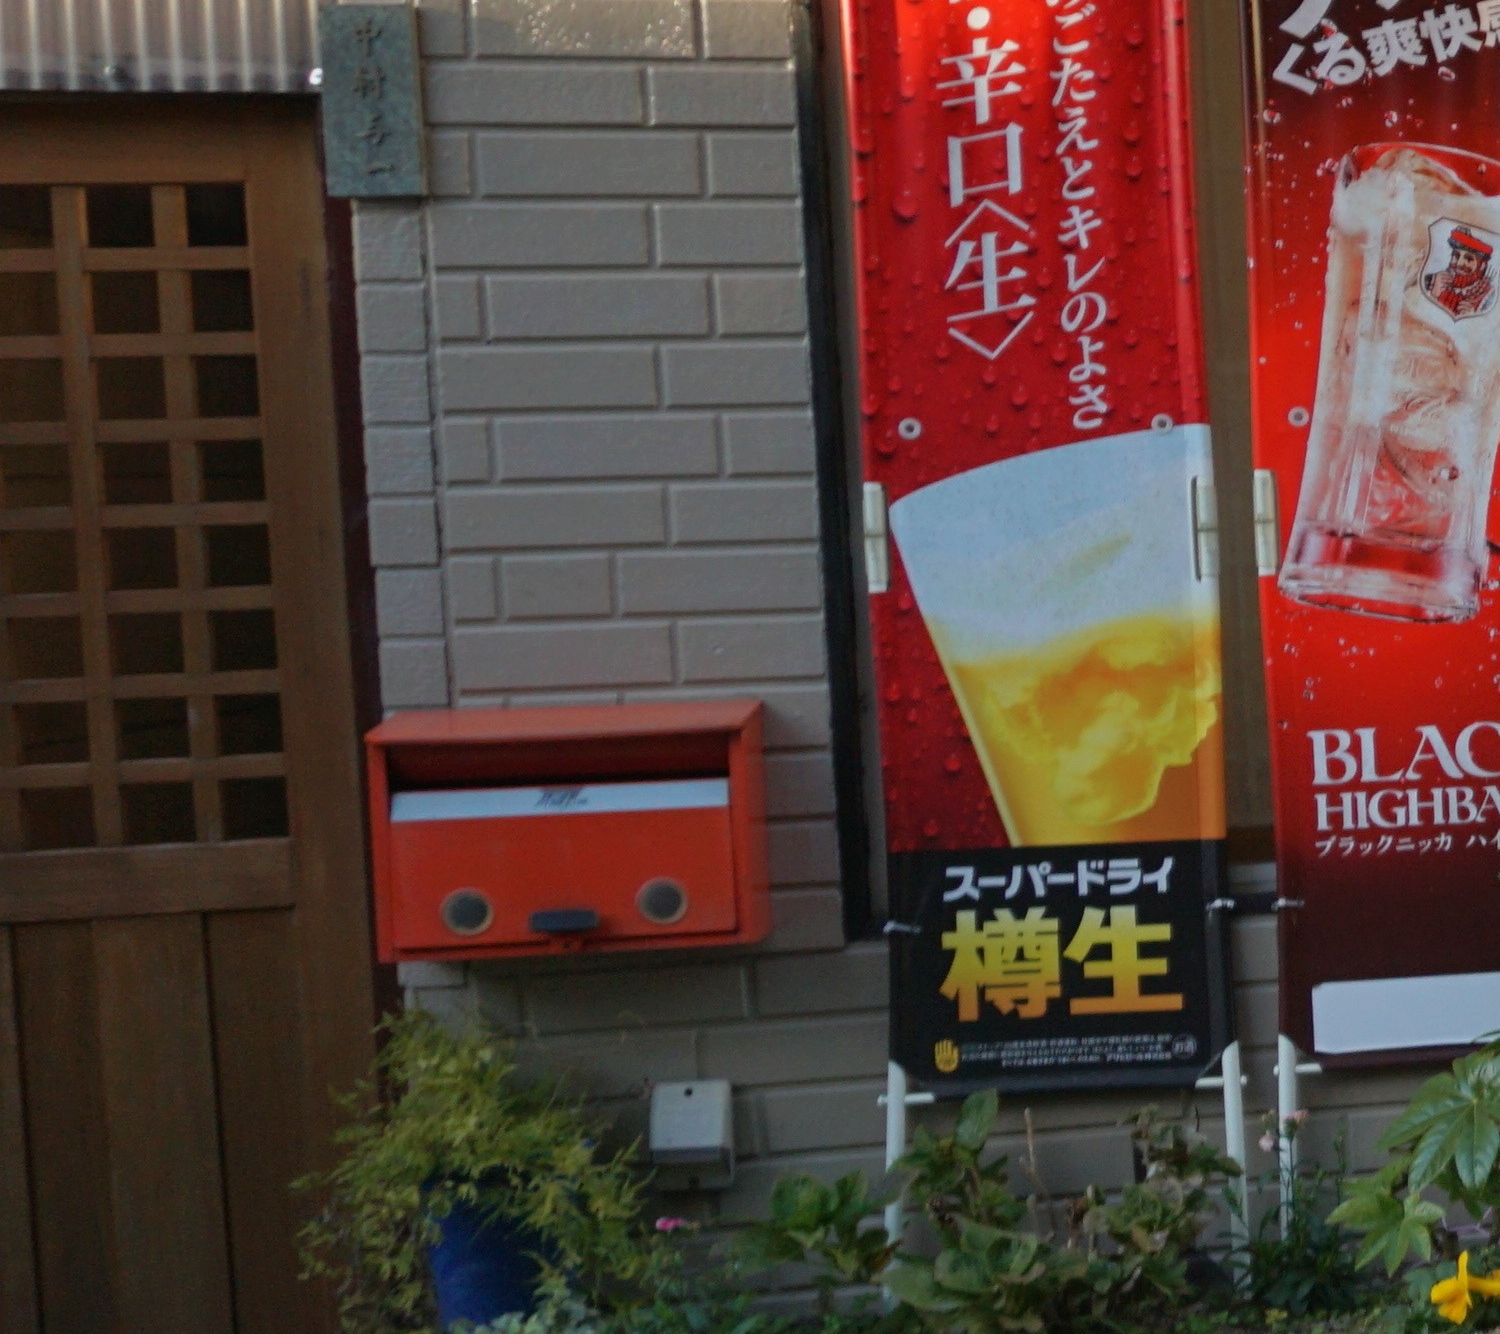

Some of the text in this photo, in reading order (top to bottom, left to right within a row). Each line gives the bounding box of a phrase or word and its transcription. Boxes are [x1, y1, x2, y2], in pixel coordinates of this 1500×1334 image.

[1315, 831, 1453, 859] ブラックニッカ
[942, 856, 1176, 901] スーパードライ
[940, 905, 1184, 1023] 樽生
